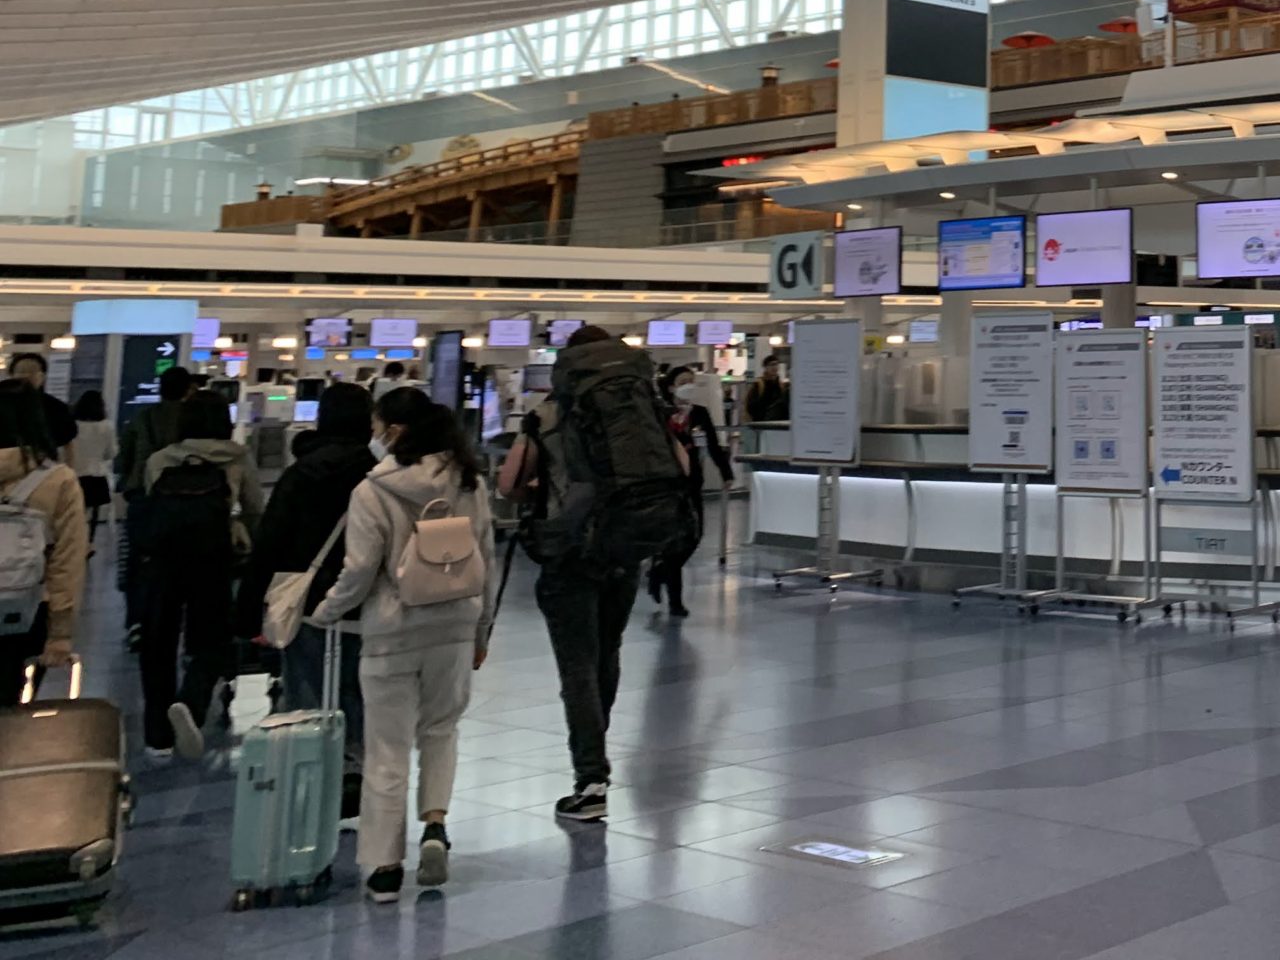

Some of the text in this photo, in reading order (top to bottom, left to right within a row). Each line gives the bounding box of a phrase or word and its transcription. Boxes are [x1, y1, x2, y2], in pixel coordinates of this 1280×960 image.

[777, 244, 798, 289] G
[1182, 474, 1226, 485] COUNTER
[1195, 537, 1227, 550] TIAT
